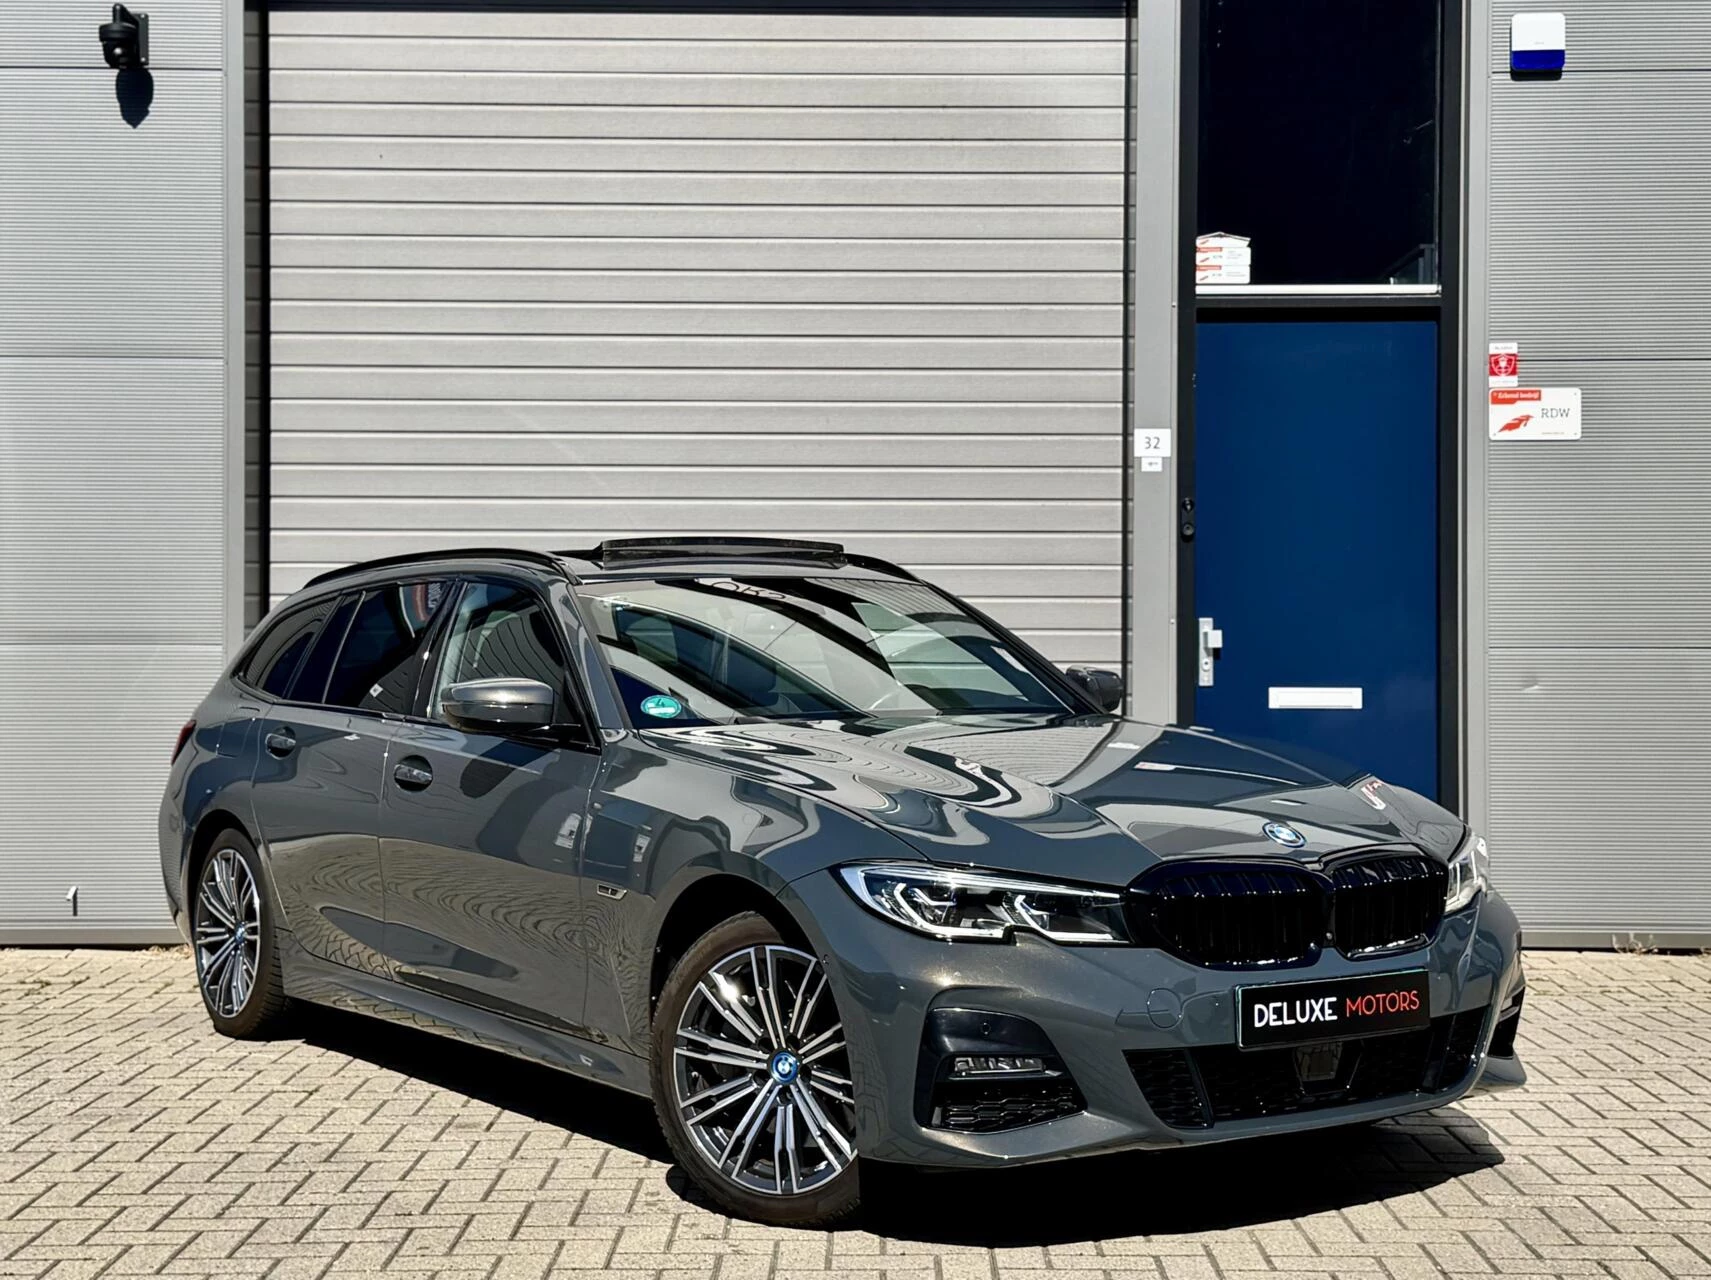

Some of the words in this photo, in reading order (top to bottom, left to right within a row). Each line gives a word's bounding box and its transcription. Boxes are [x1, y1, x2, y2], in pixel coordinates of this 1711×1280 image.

[1541, 408, 1570, 418] RDW
[1144, 436, 1161, 450] 32
[1253, 997, 1338, 1028] DELUXE
[1346, 990, 1420, 1018] MOTORS
